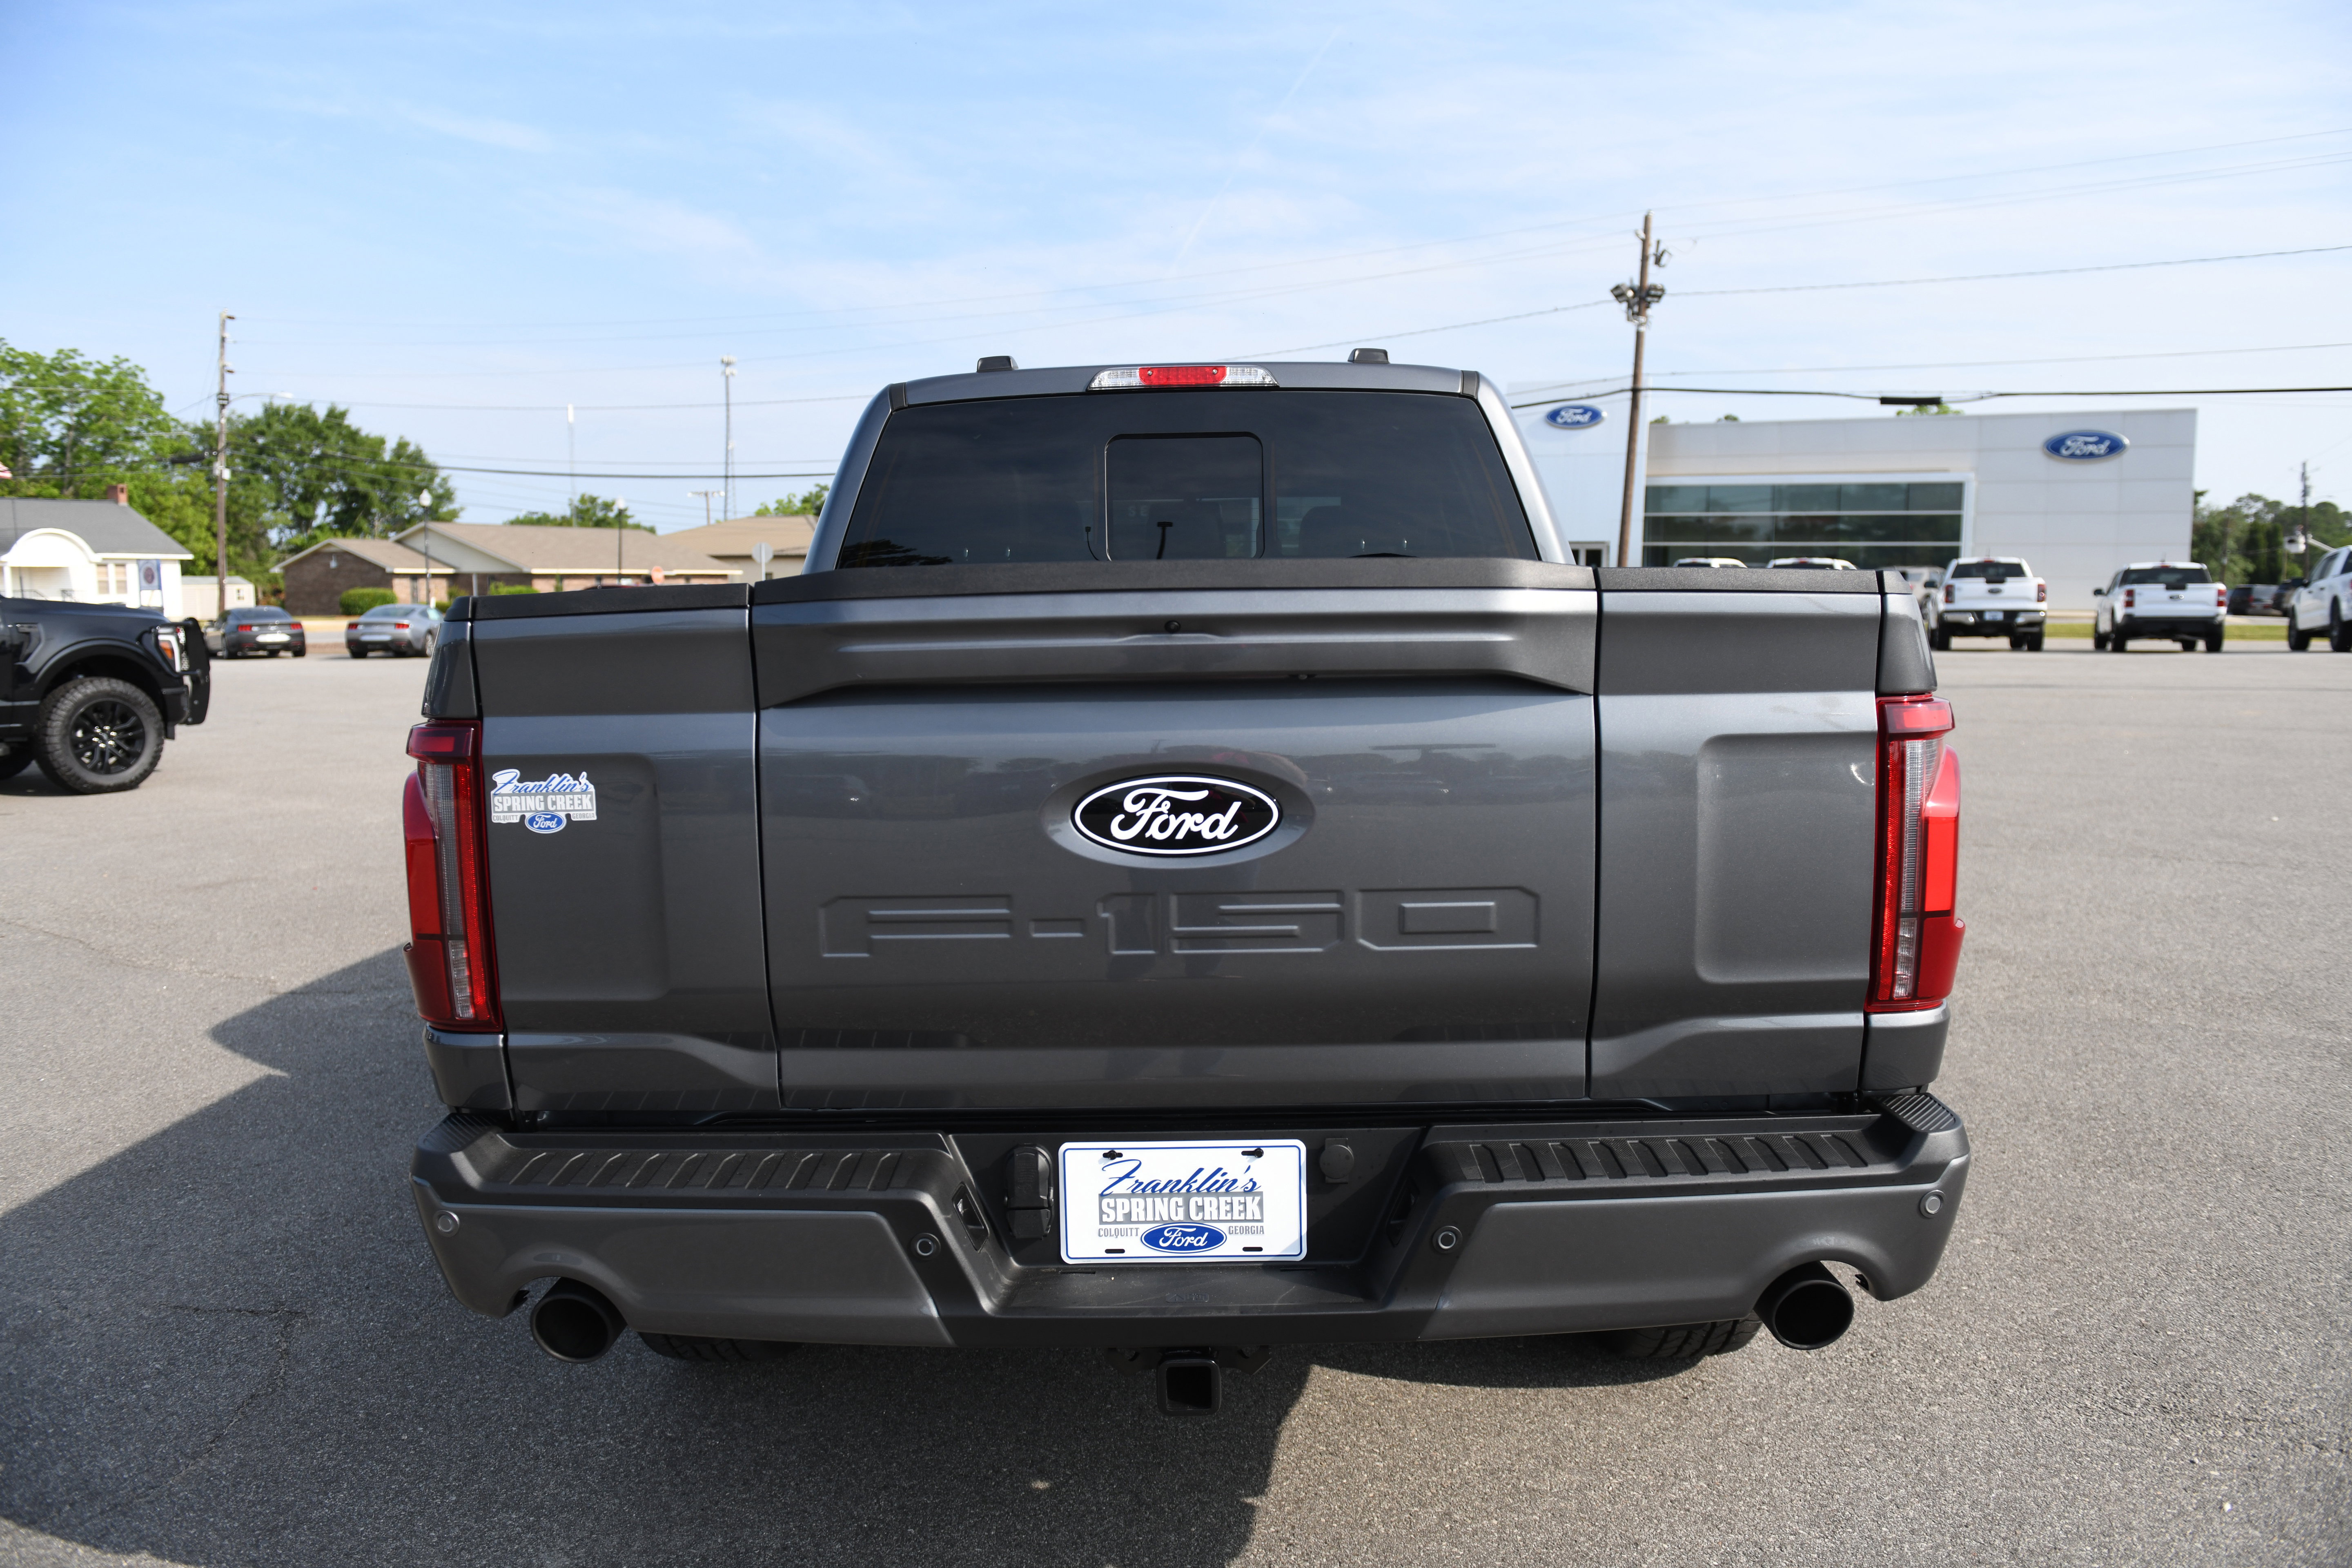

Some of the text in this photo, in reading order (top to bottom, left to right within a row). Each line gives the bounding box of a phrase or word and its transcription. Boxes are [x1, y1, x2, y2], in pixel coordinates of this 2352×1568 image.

[1556, 408, 1592, 423] Ford
[2060, 435, 2111, 456] Ford
[493, 771, 592, 795] Franklin's
[494, 794, 592, 811] SPRING CREEK
[533, 813, 558, 828] Ford
[1110, 788, 1242, 840] Ford
[820, 886, 1540, 958] F-150
[1100, 1159, 1262, 1197] Franklin's
[1102, 1195, 1262, 1222] SPRING CREEK
[1098, 1227, 1140, 1238] COLQUITT
[1159, 1226, 1208, 1247] Ford
[1228, 1225, 1265, 1235] GEORGIA
